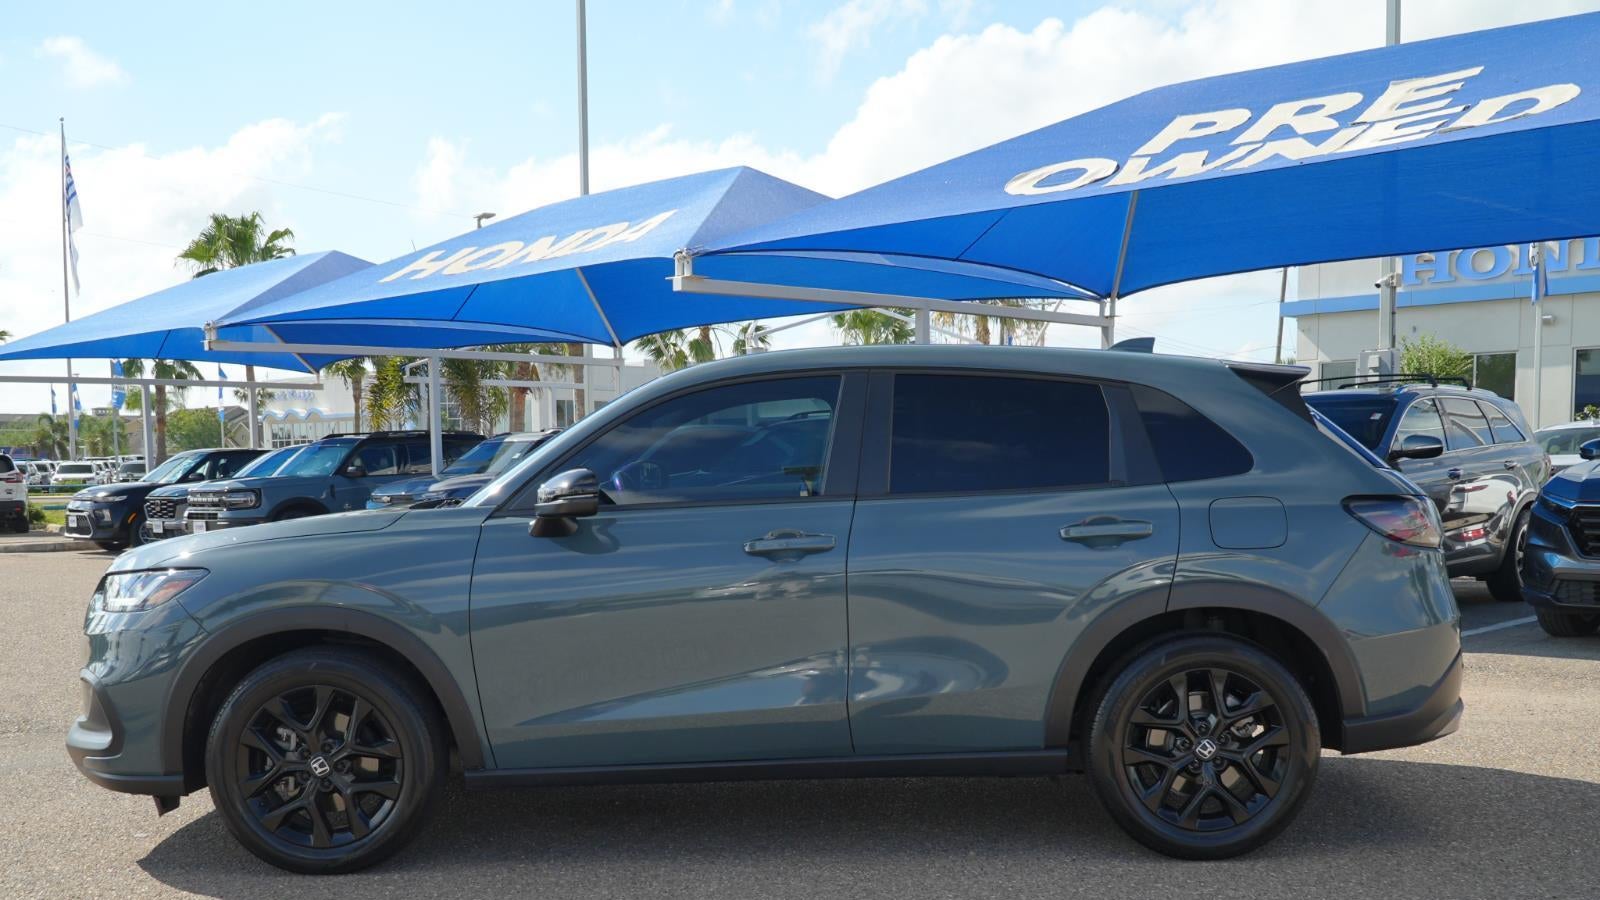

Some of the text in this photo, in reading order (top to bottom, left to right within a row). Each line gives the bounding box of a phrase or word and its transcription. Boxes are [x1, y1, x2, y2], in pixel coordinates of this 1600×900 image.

[1003, 82, 1582, 197] OWNED
[1130, 65, 1485, 157] PRE
[377, 208, 679, 284] HONDA
